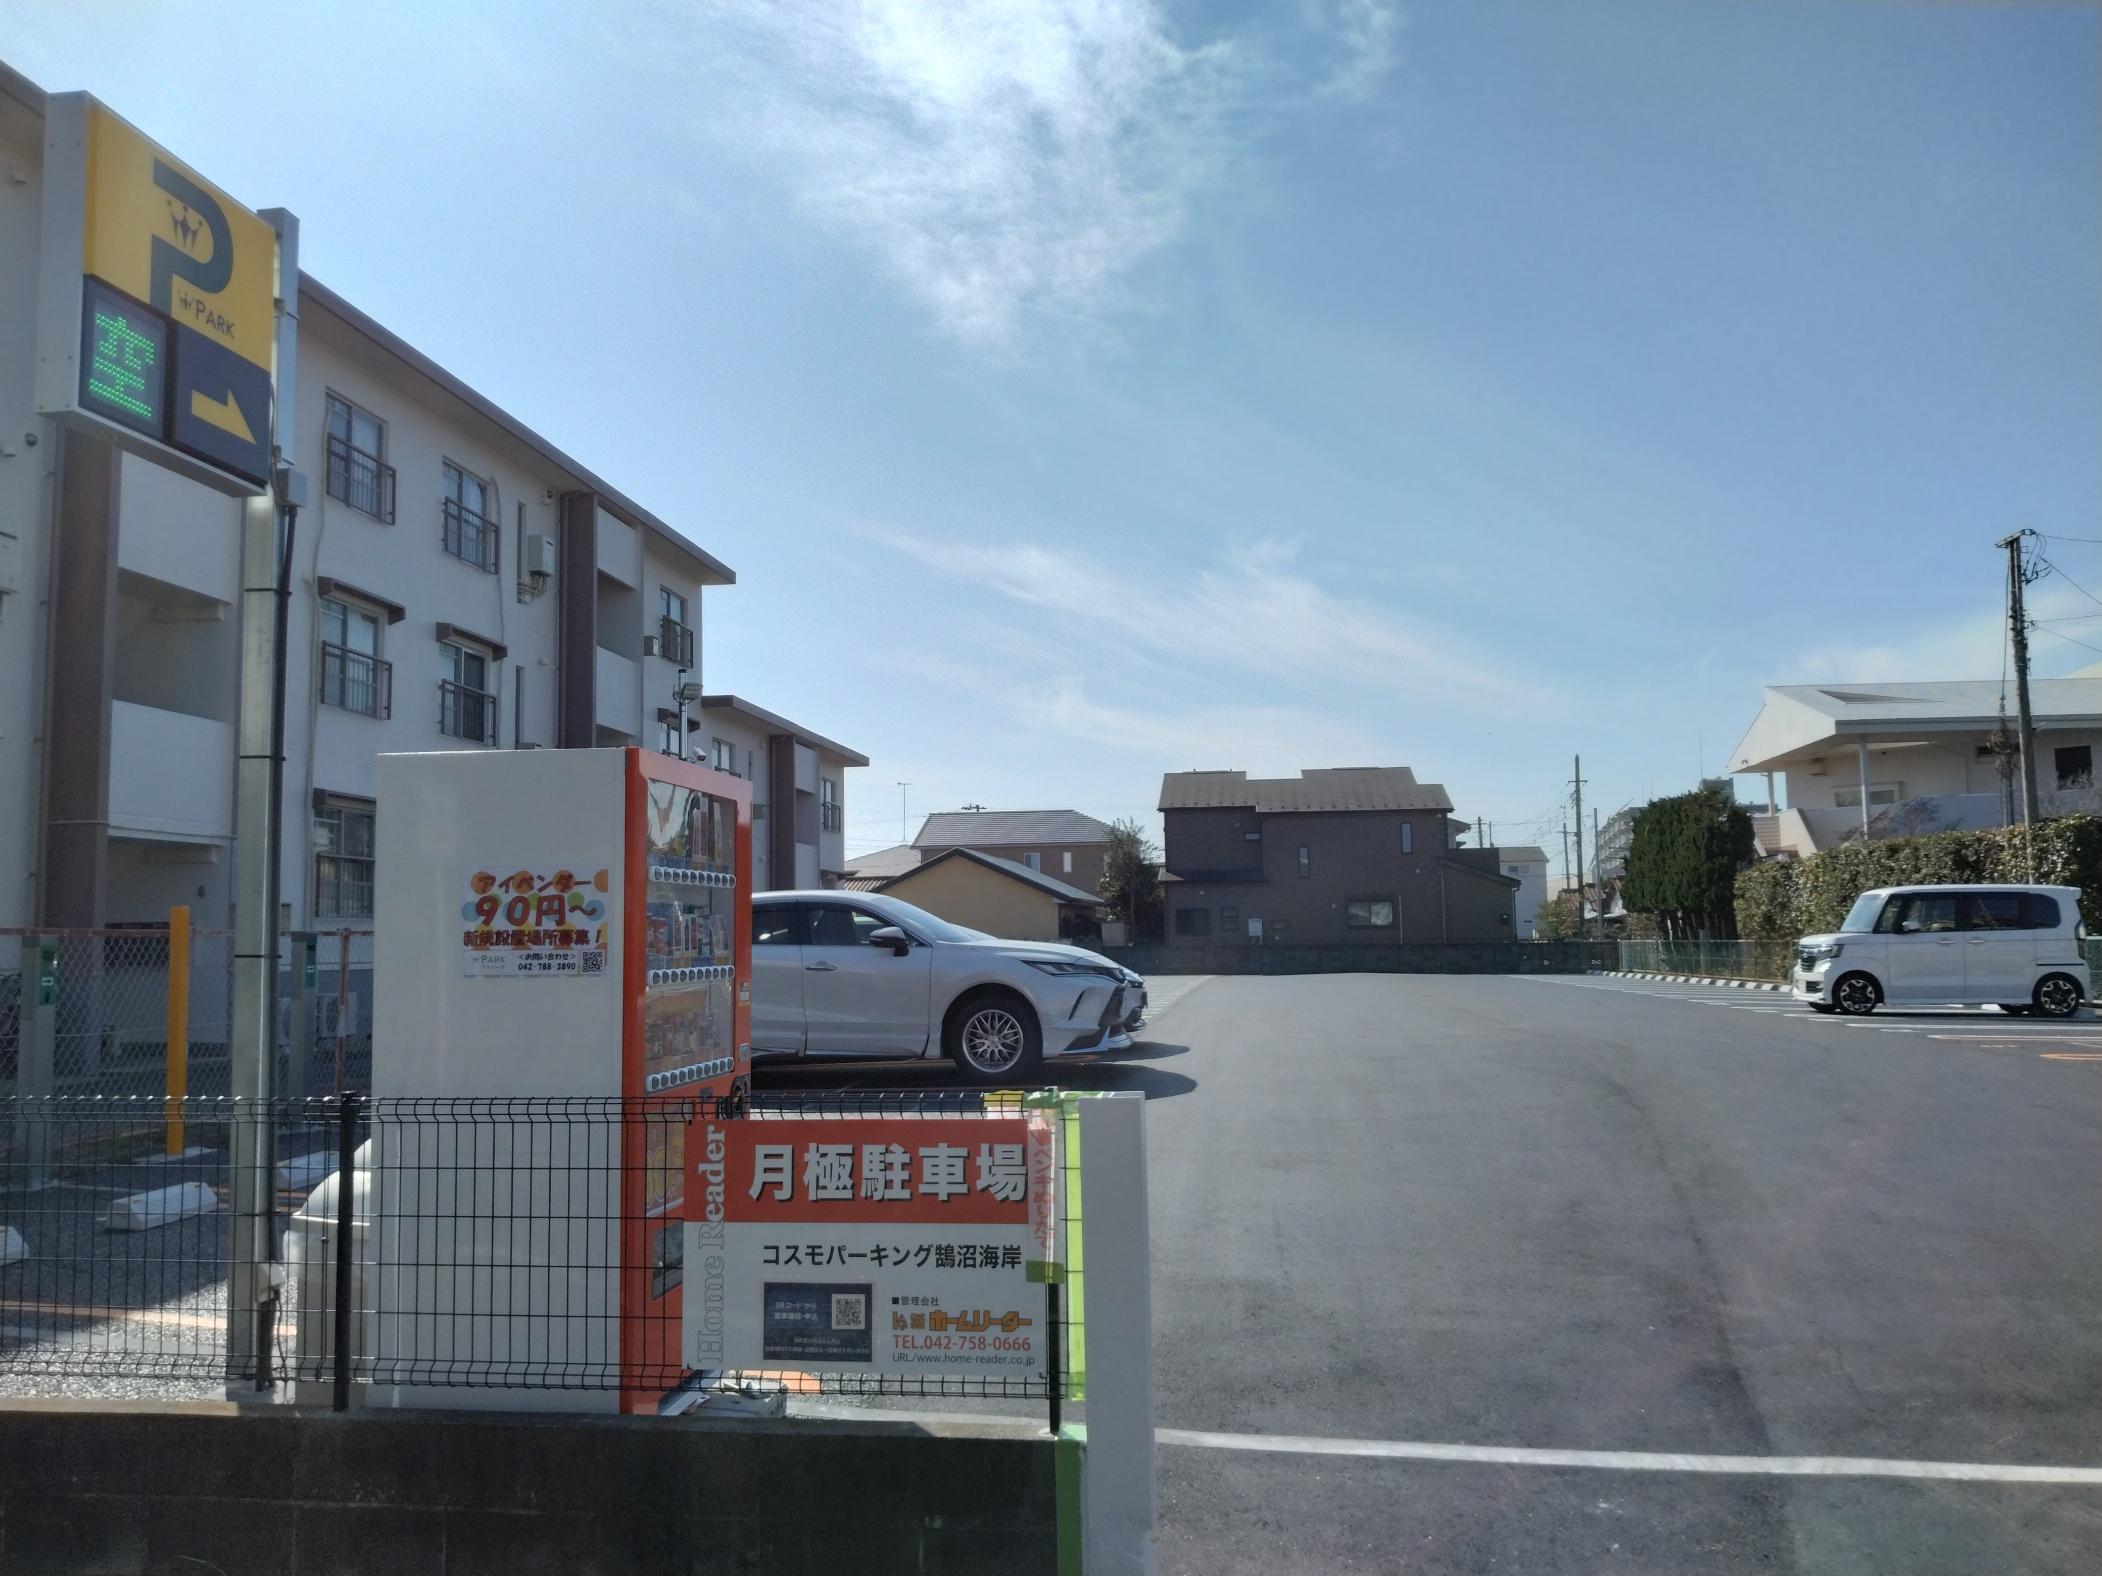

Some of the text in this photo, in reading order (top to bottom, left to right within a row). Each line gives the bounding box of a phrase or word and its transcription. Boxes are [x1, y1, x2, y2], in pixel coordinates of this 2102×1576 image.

[152, 157, 234, 318] P
[194, 298, 236, 339] PARK
[88, 313, 156, 419] 空
[481, 955, 506, 964] PARK
[748, 1142, 1028, 1203] 月極駐車場
[697, 1124, 727, 1364] Home Reader
[763, 1243, 1023, 1270] コスモパーキング鵠沼海岸
[901, 1296, 940, 1306] 管理会社
[929, 1309, 1033, 1332] ホームリーダー
[892, 1335, 1032, 1351] TEL.042-758-0666
[892, 1353, 1036, 1367] URL/www.home-reader.co.jp
